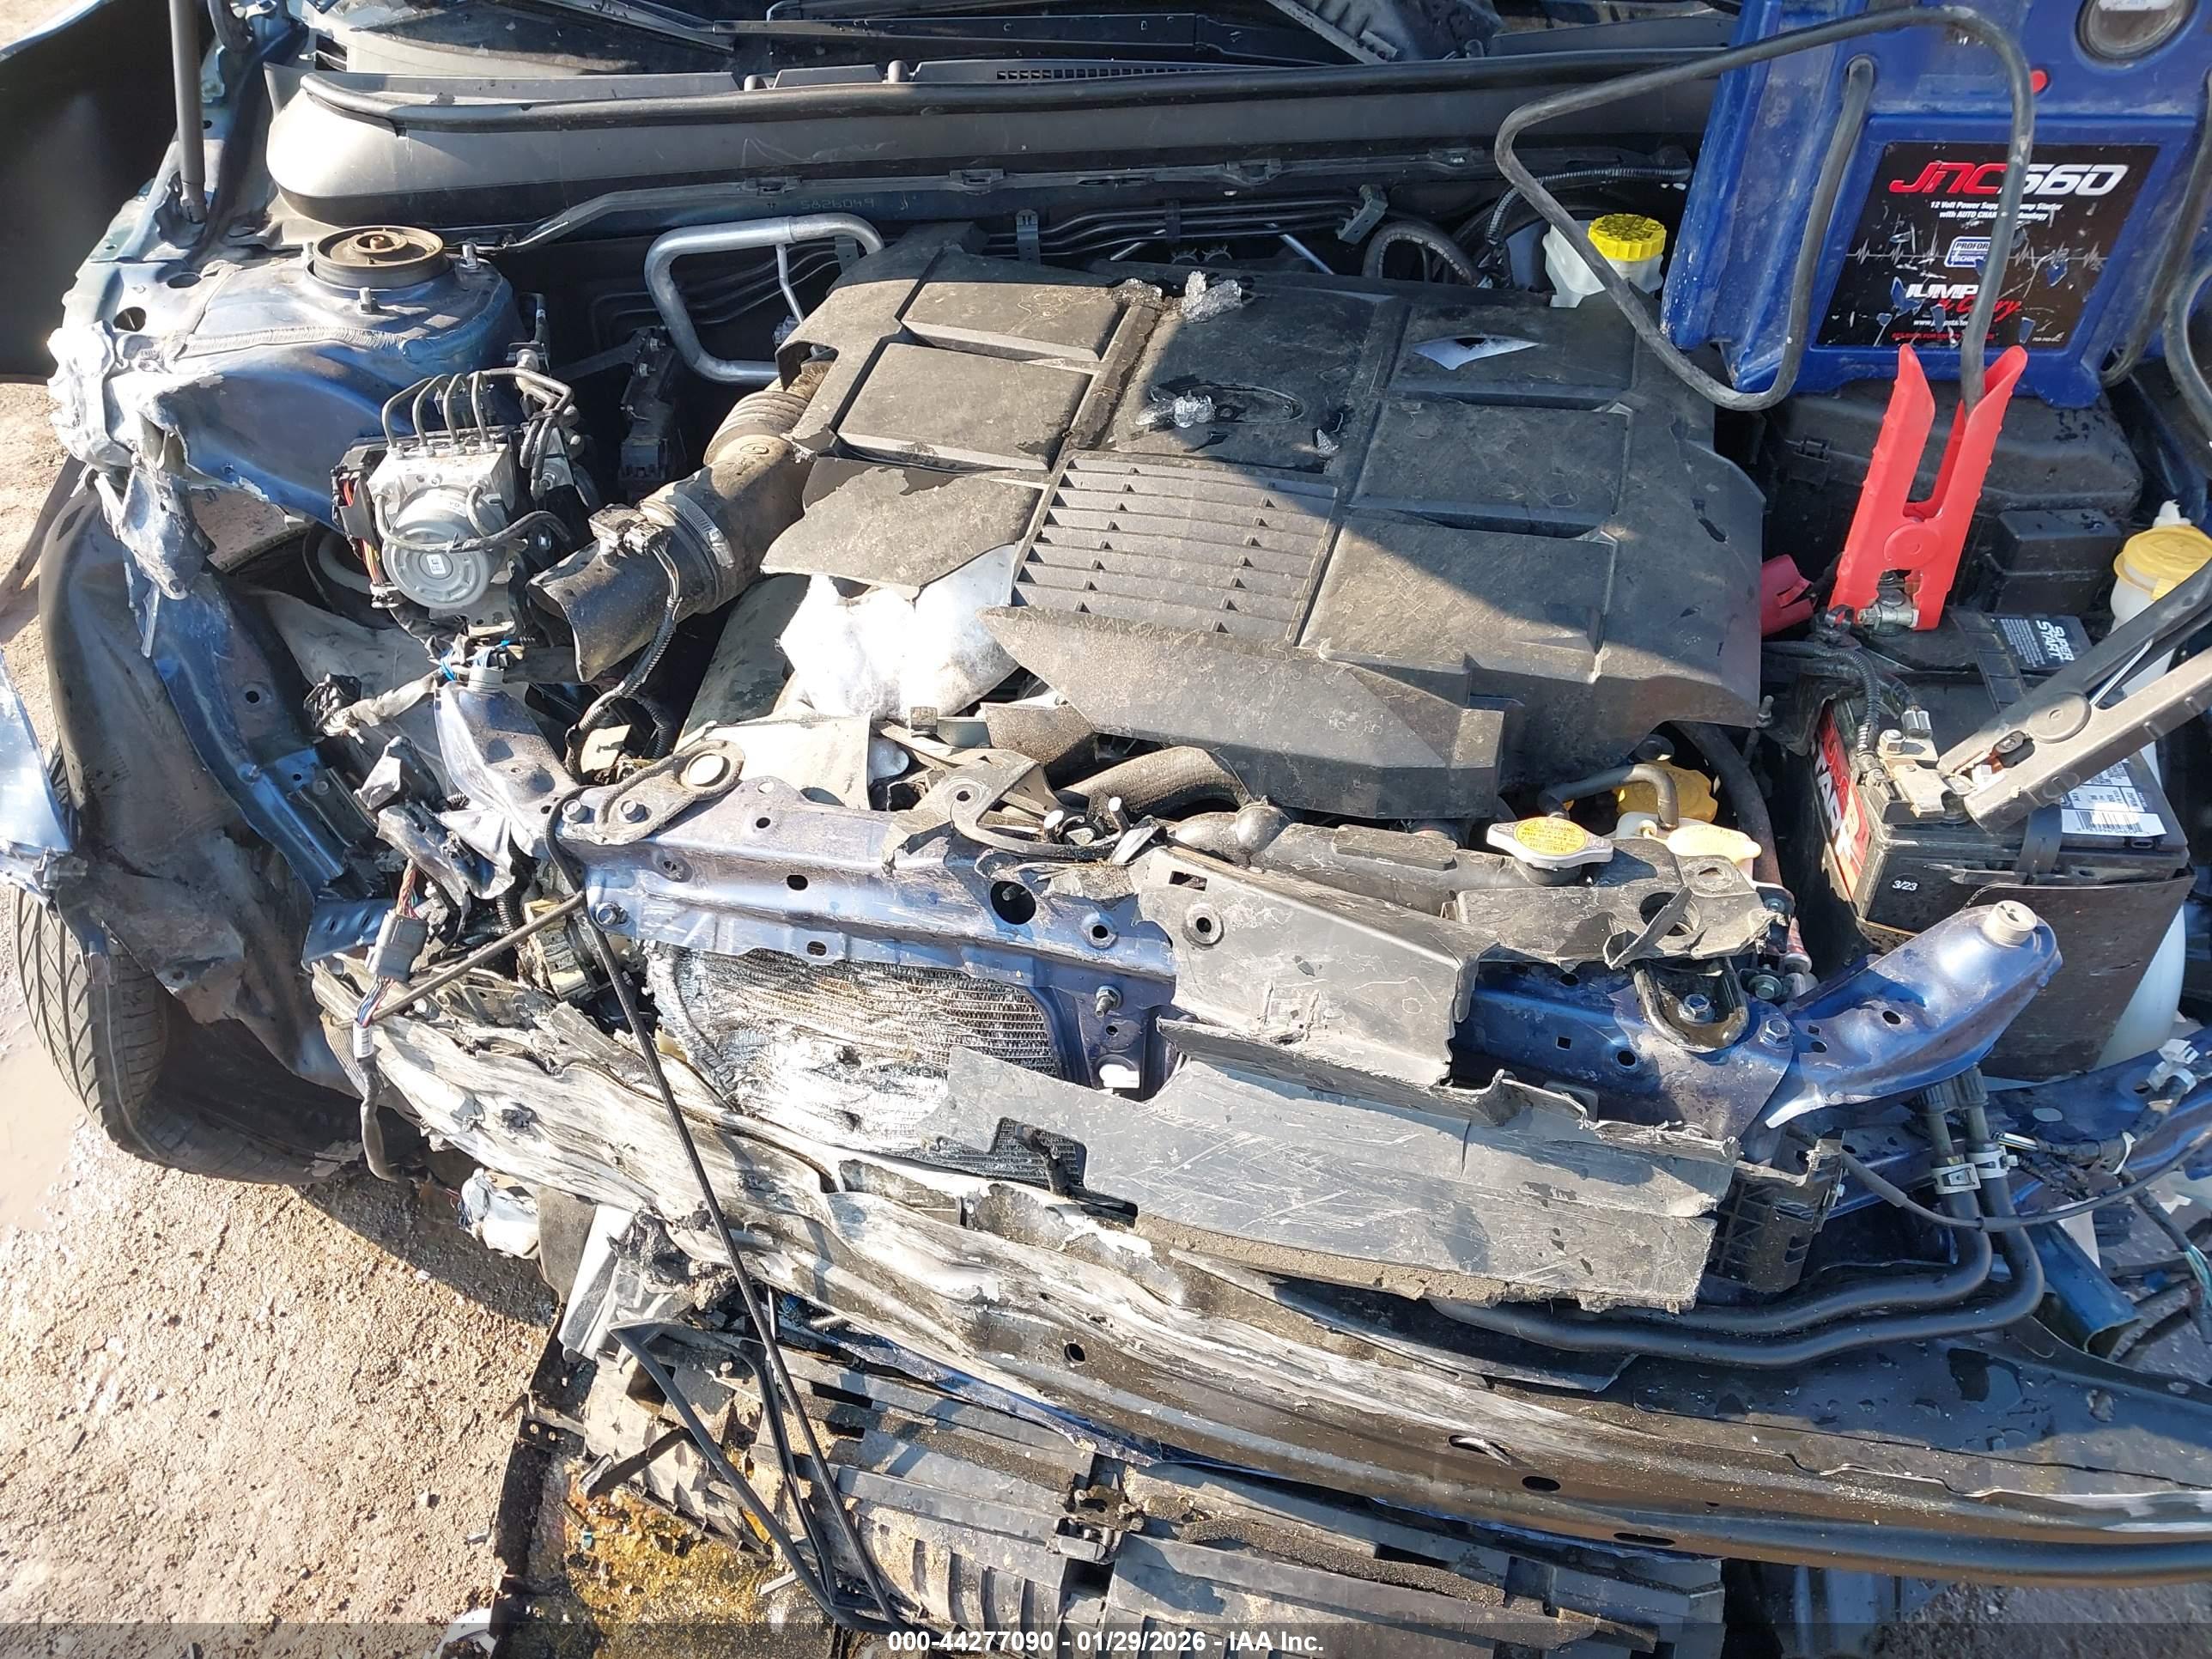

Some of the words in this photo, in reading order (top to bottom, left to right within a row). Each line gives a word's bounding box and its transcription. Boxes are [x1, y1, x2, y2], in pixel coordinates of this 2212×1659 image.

[2036, 620, 2064, 662] START
[2053, 625, 2075, 661] SUPER
[1892, 880, 1918, 891] 3/23
